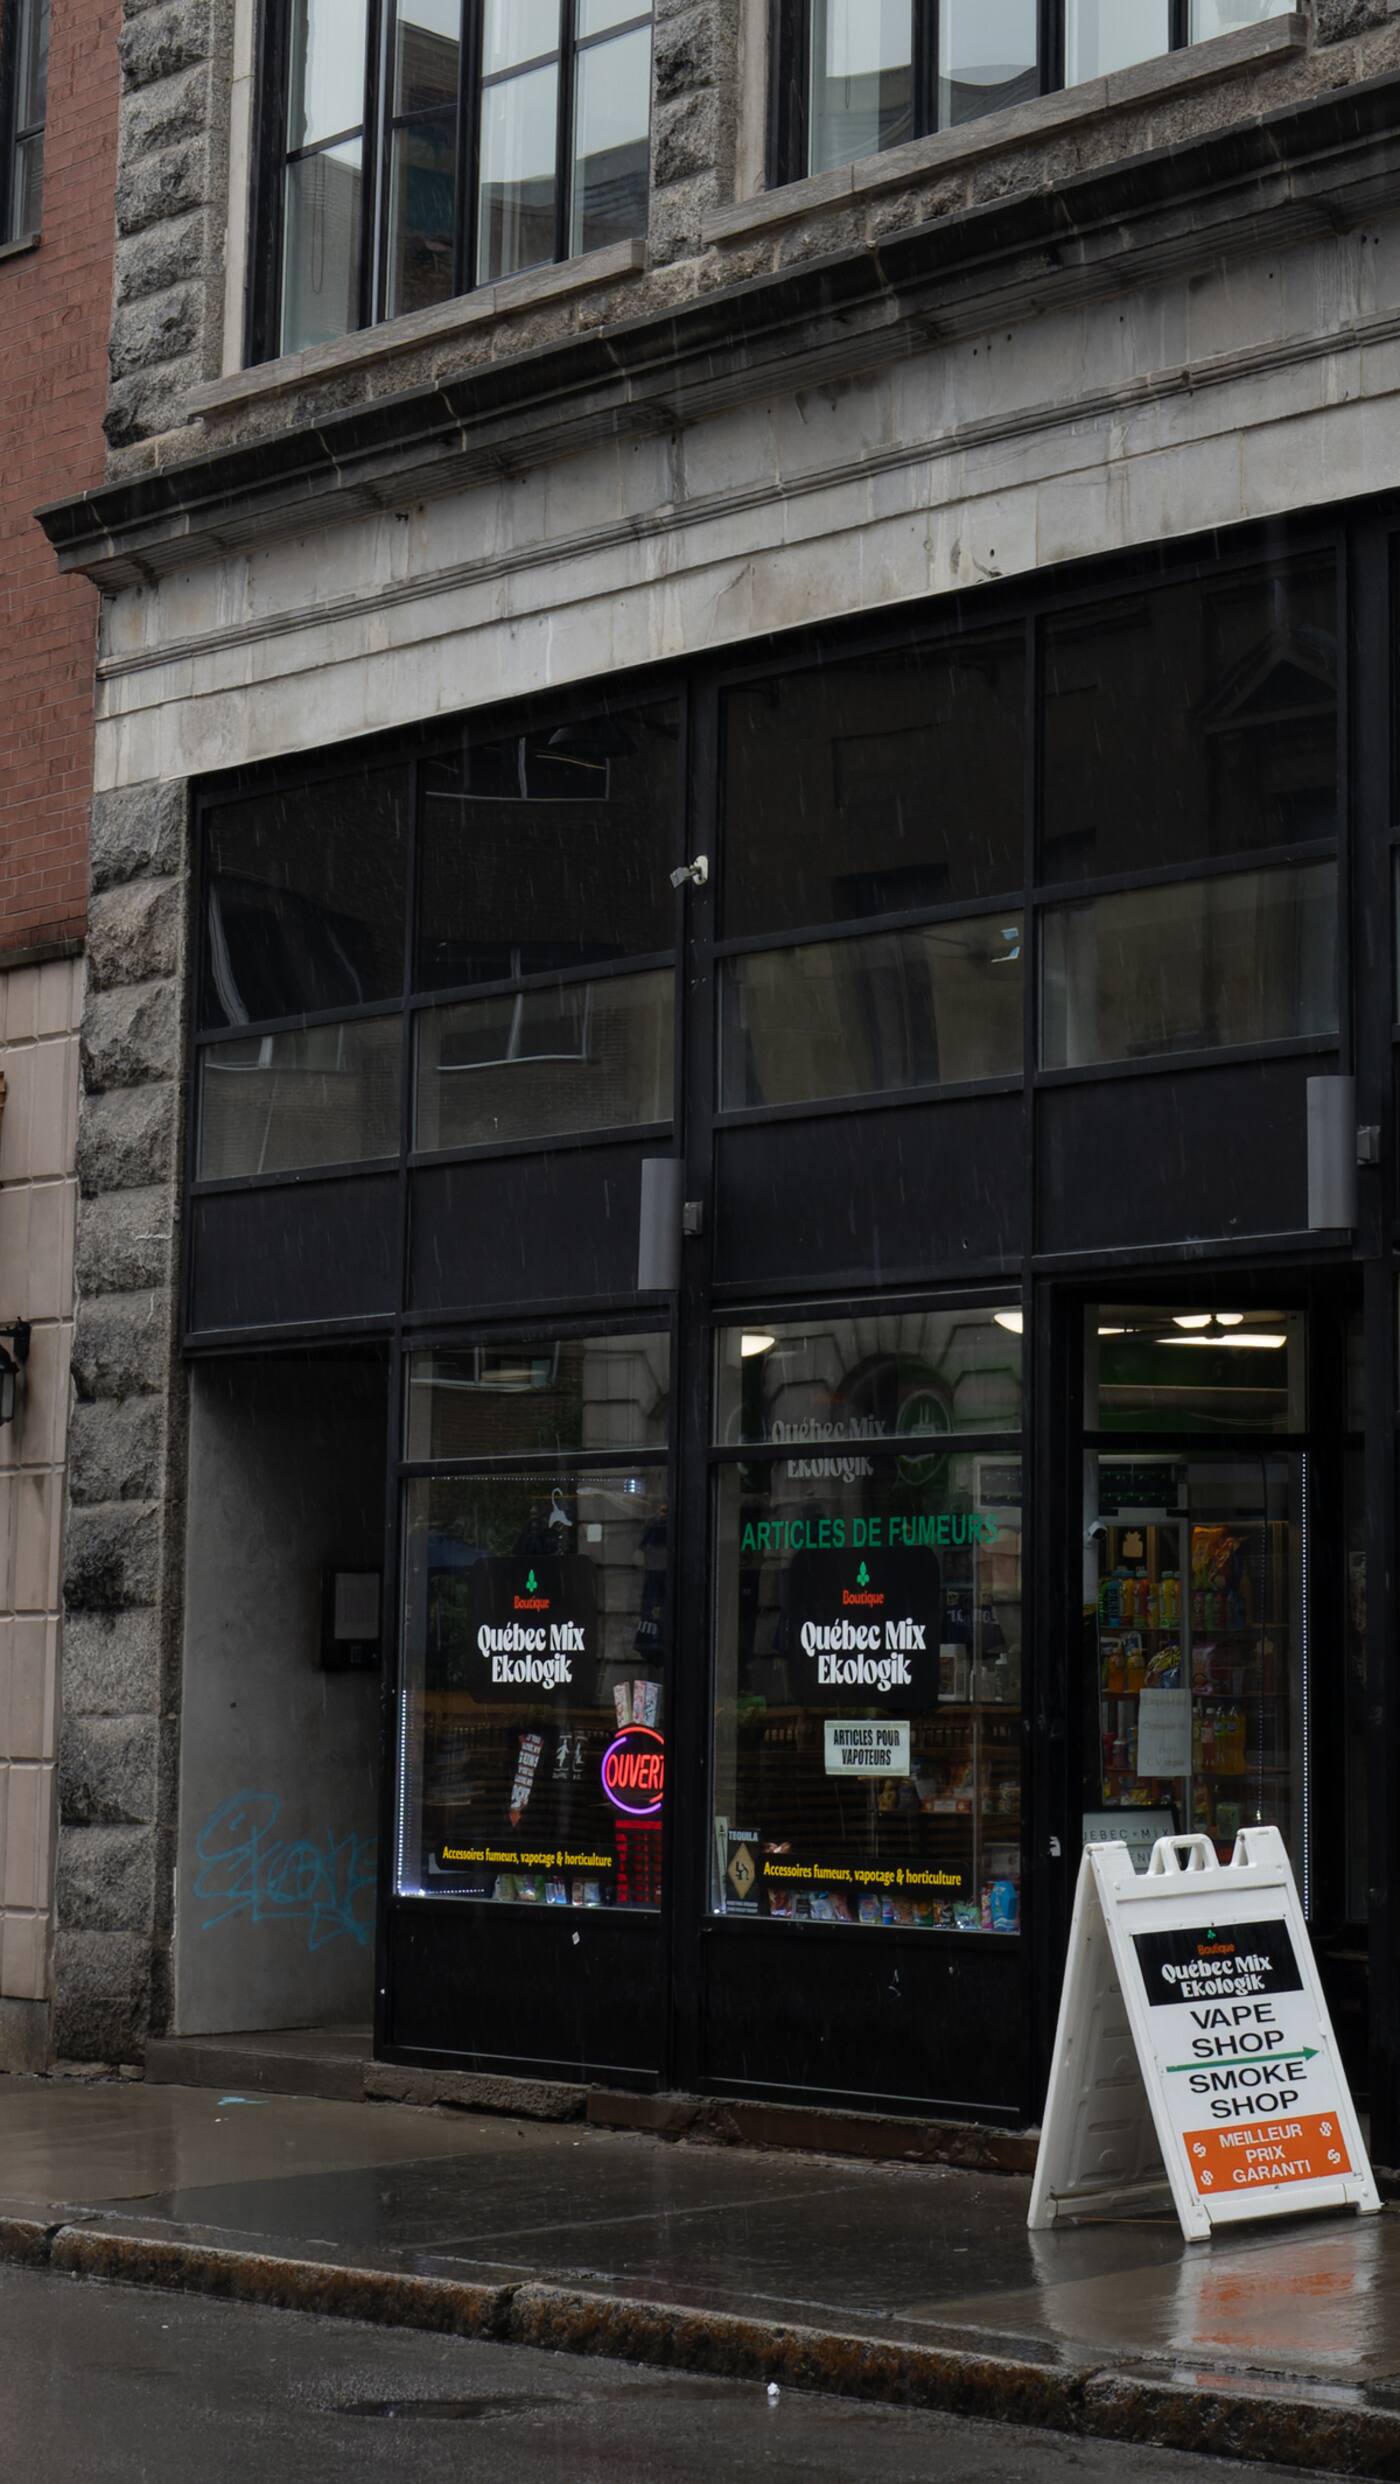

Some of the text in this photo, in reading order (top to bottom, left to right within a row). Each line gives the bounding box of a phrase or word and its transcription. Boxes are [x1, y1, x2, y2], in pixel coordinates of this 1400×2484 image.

[741, 1513, 999, 1551] ARTICLES DE FUMEURS
[514, 1595, 550, 1612] Boutique
[842, 1590, 885, 1608] Boutique
[477, 1621, 585, 1658] Québec Mix
[800, 1617, 926, 1657] Québec Mix
[492, 1653, 572, 1689] Ekologik
[818, 1652, 912, 1692] Ekologik
[833, 1729, 900, 1746] ARTICLES POUR
[842, 1749, 892, 1766] VAPOTEURS
[443, 1846, 484, 1861] Accessoires
[520, 1852, 555, 1868] vapotage
[565, 1851, 612, 1867] horticulture
[764, 1862, 812, 1878] Accessoires
[814, 1864, 852, 1882] fumeurs,
[854, 1869, 895, 1886] vapotage
[906, 1869, 962, 1886] horticulture
[1161, 1954, 1273, 1984] Québec Mix
[1181, 1974, 1265, 1998] Ekologik
[1190, 2003, 1276, 2029] VAPE
[1192, 2030, 1284, 2058] SHOP
[1189, 2061, 1308, 2094] SMOKE
[1210, 2090, 1298, 2119] SHOP
[1219, 2123, 1303, 2148] MEILLEUR
[1245, 2145, 1286, 2163] PRIX
[1232, 2160, 1312, 2183] GARANTI
